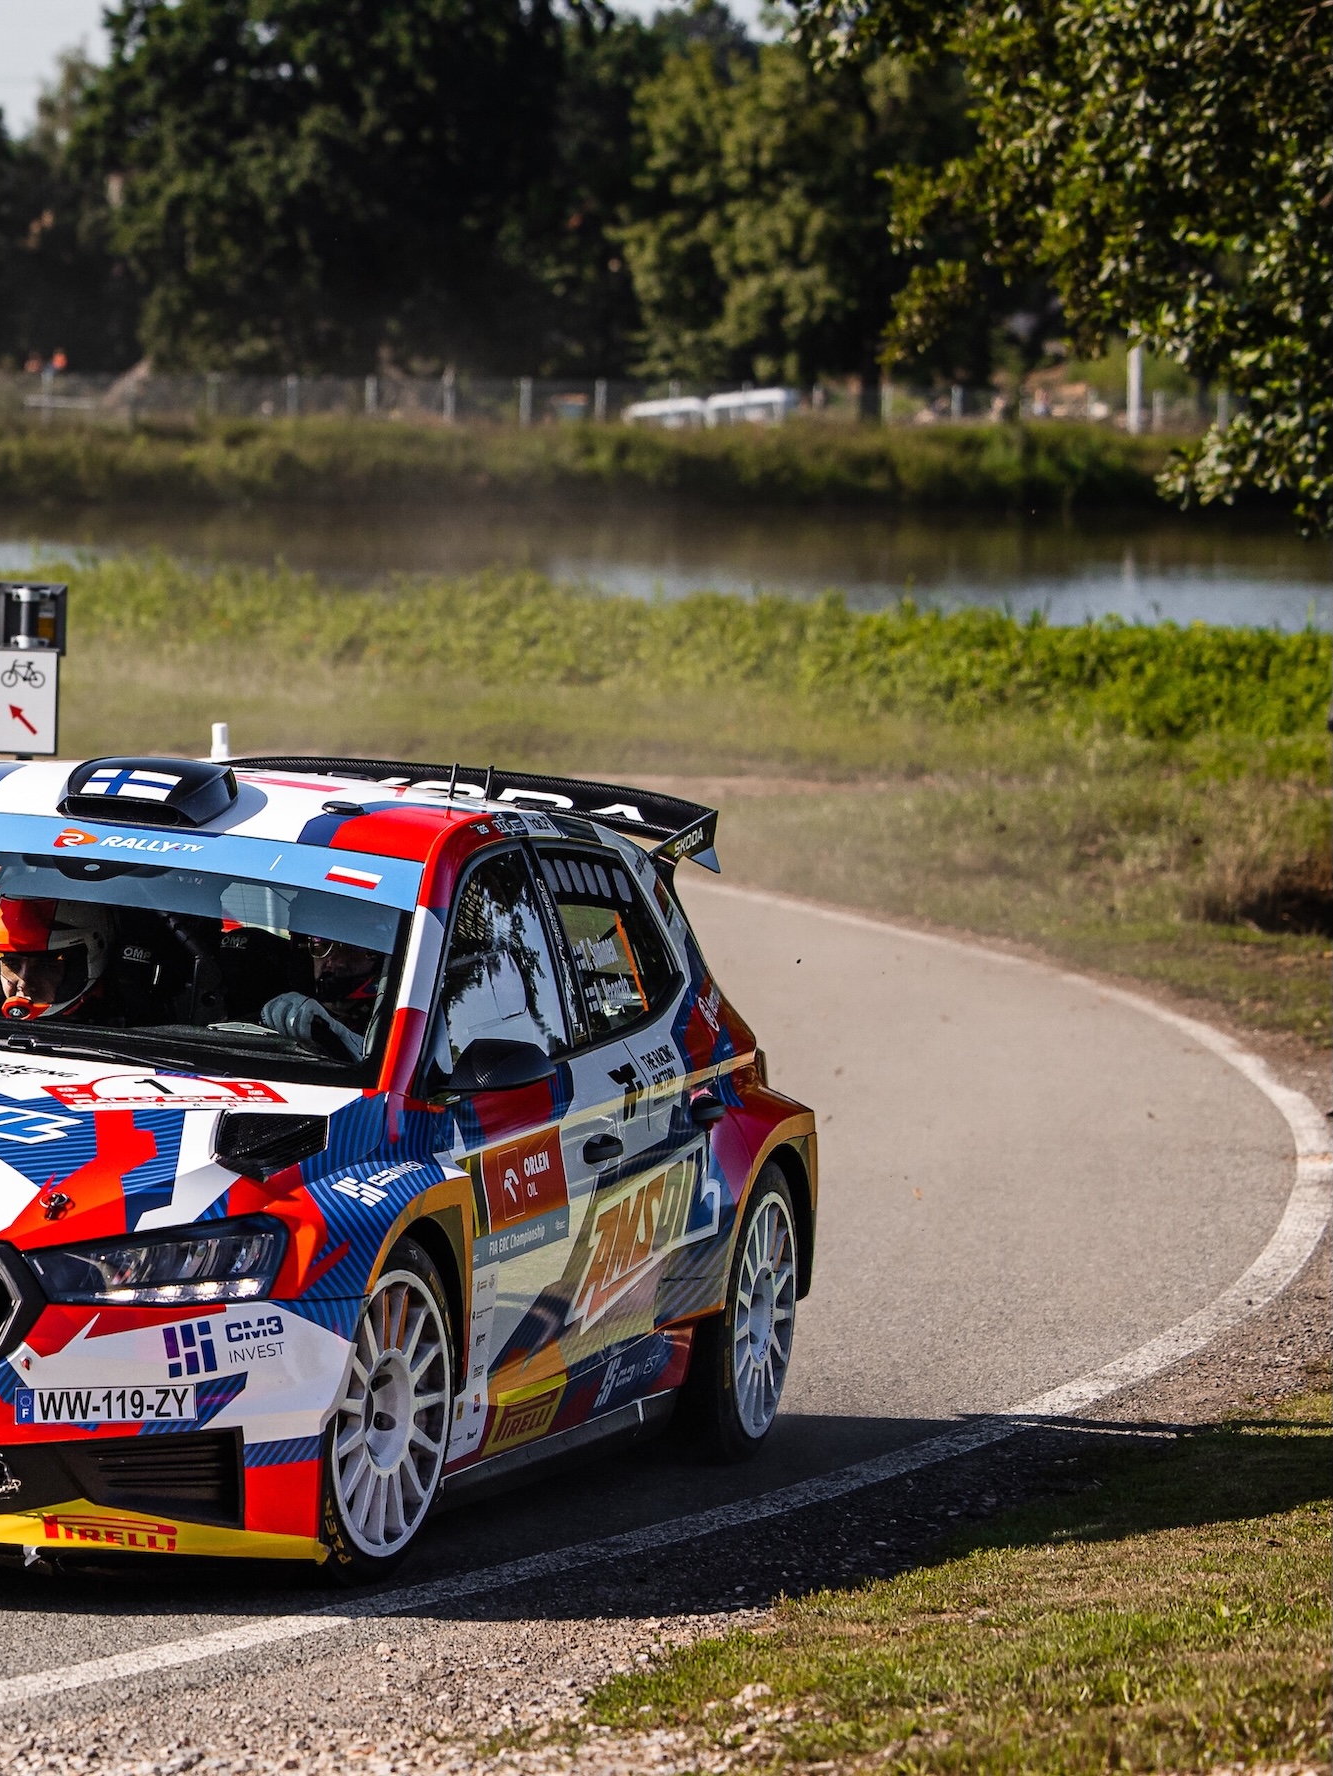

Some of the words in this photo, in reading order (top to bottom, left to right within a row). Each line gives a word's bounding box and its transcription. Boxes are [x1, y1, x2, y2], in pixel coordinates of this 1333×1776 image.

[674, 826, 704, 857] SKODA
[123, 946, 151, 960] OMP
[220, 936, 247, 946] OMP
[133, 1078, 175, 1095] 1
[73, 1096, 159, 1104] RALLY
[160, 1096, 274, 1104] POLAND
[523, 1150, 550, 1177] ORLEN
[526, 1181, 538, 1198] OIL
[489, 1240, 499, 1258] FIA
[499, 1235, 510, 1254] ERC
[510, 1223, 546, 1248] Championship
[225, 1315, 284, 1343] CM3
[228, 1341, 285, 1364] INVEST
[21, 1408, 29, 1419] F
[38, 1387, 190, 1421] WW-119-ZY
[491, 1387, 561, 1445] PIRELLI
[43, 1515, 178, 1552] PIRELLI
